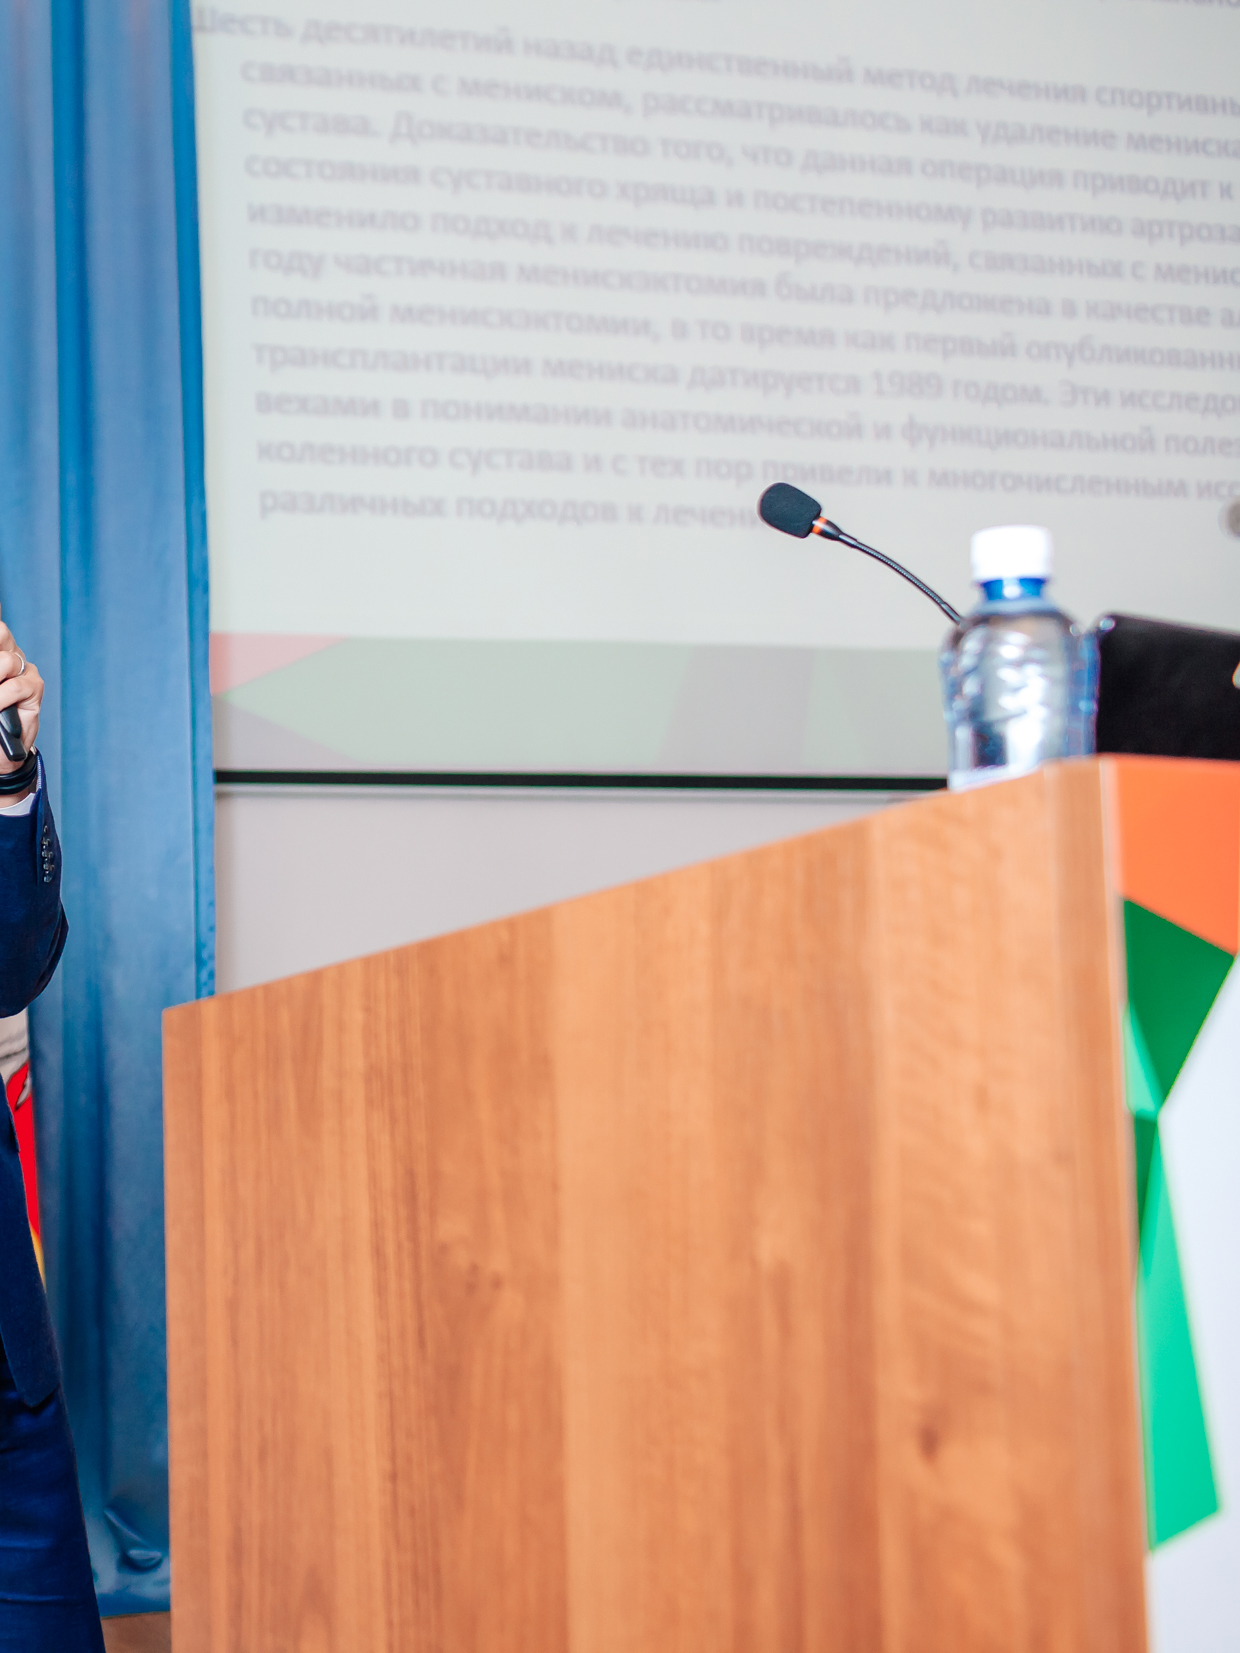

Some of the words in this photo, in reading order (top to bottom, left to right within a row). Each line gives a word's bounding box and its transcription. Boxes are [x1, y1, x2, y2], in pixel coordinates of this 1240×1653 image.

[300, 19, 515, 55] десятилетий
[523, 39, 620, 69] назад
[625, 46, 855, 84] единственный
[863, 67, 960, 99] метод
[964, 75, 1089, 105] лечения
[240, 61, 423, 93] связанных
[430, 74, 448, 97] с
[458, 77, 632, 114] мениском,
[642, 92, 913, 134] рассматривалось
[919, 116, 969, 138] как
[975, 121, 1120, 151] удаление
[242, 108, 380, 137] сустава.
[389, 111, 651, 157] Доказательство
[660, 138, 734, 167] того,
[742, 145, 794, 168] что
[800, 149, 914, 177] данная
[919, 158, 1066, 191] операция
[1072, 170, 1212, 204] приводит
[1217, 180, 1236, 202] к
[244, 155, 422, 185] состояния
[430, 167, 609, 199] суставного
[616, 182, 718, 210] хряща
[725, 189, 746, 209] и
[753, 190, 974, 232] постепенному
[980, 207, 1125, 237] развитию
[247, 203, 422, 233] изменило
[431, 213, 555, 245] подход
[560, 222, 579, 244] к
[587, 224, 730, 253] лечению
[738, 234, 960, 273] повреждений,
[968, 250, 1125, 280] связанных
[1129, 260, 1147, 283] с
[249, 248, 326, 280] году
[333, 254, 508, 282] частичная
[516, 263, 768, 299] менискэктомия
[774, 272, 856, 305] была
[863, 286, 1053, 318] предложена
[1060, 297, 1080, 321] в
[1085, 300, 1214, 328] качестве
[251, 294, 381, 323] полной
[389, 304, 660, 343] менискэктомии,
[670, 318, 690, 341] в
[697, 320, 732, 342] то
[740, 323, 837, 351] время
[844, 331, 896, 352] как
[904, 332, 1019, 361] первый
[253, 343, 533, 380] трансплантации
[542, 358, 680, 385] мениска
[687, 366, 862, 398] датируется
[872, 370, 945, 399] 1989
[951, 379, 1050, 408] годом.
[1061, 380, 1113, 408] Эти
[1119, 390, 1240, 419] исследо
[255, 391, 382, 418] вехами
[390, 397, 412, 421] в
[421, 399, 613, 427] понимании
[621, 408, 865, 440] анатомической
[872, 421, 894, 442] и
[900, 414, 1157, 454] функциональной
[257, 441, 441, 469] коленного
[448, 447, 574, 476] сустава
[582, 453, 604, 474] и
[610, 453, 627, 476] с
[637, 456, 685, 478] тех
[695, 458, 755, 487] пор
[901, 467, 920, 488] к
[928, 468, 1190, 503] многочисленным
[259, 490, 447, 519] различных
[456, 497, 619, 526] подходов
[626, 503, 645, 525] к
